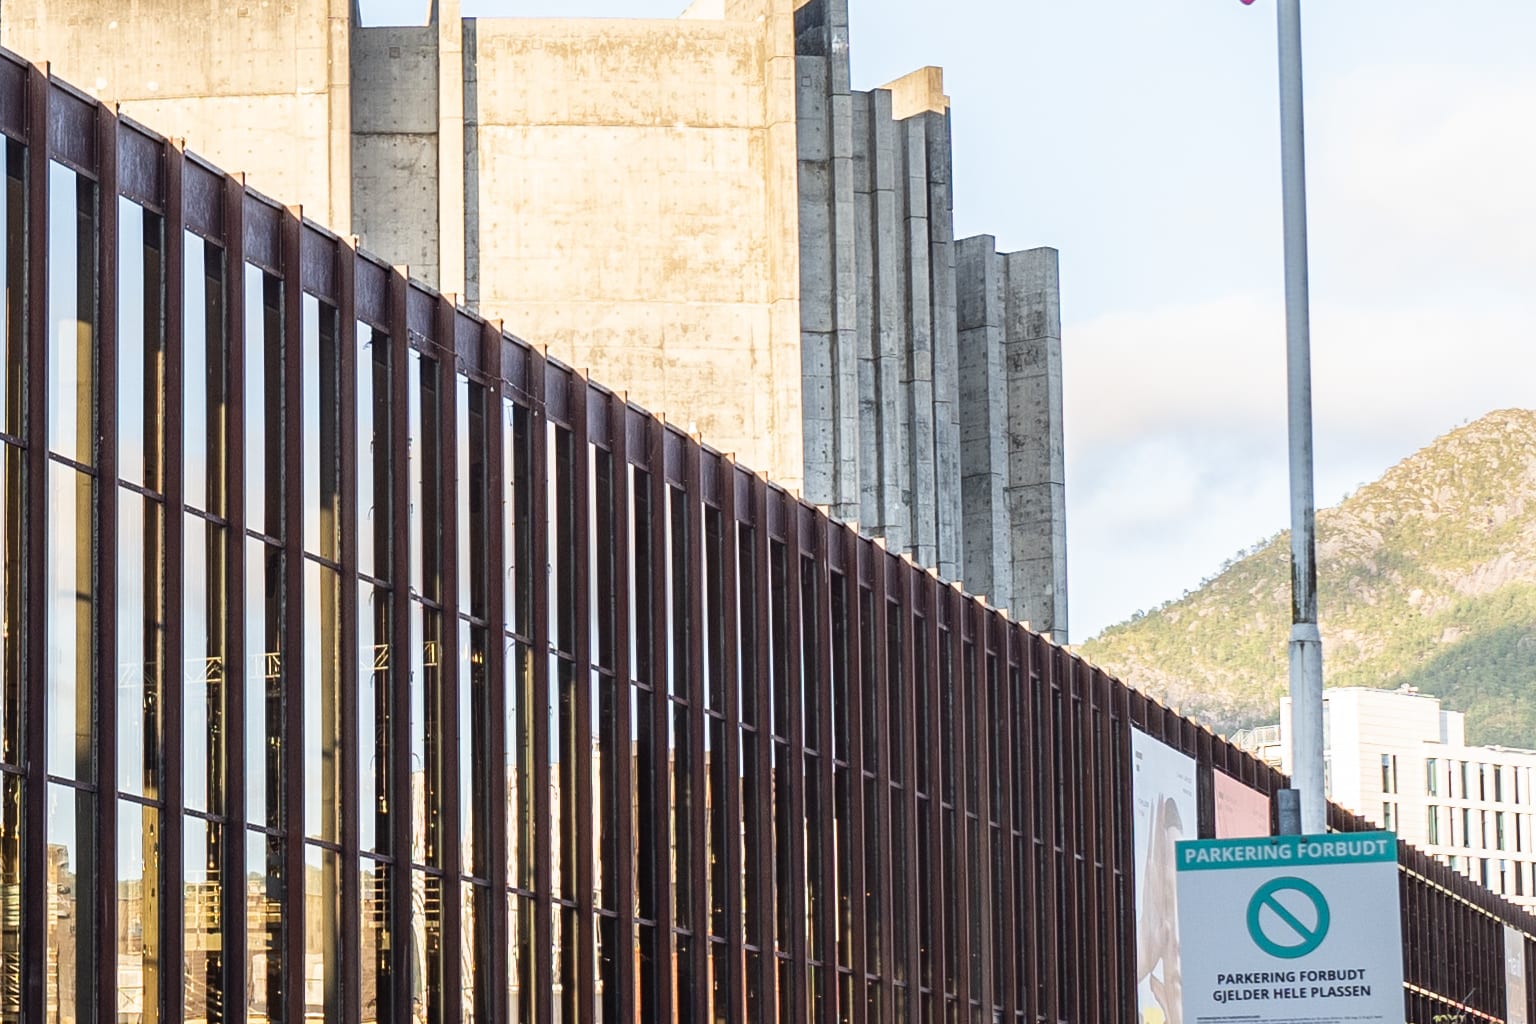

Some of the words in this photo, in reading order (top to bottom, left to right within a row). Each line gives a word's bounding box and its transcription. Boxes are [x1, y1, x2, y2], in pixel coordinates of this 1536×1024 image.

[1184, 844, 1293, 864] PARKERING
[1296, 839, 1388, 859] FORBUDT
[1217, 971, 1296, 985] PARKERING
[1299, 968, 1366, 982] FORBUDT
[1212, 988, 1270, 1004] GJELDER
[1273, 987, 1307, 1000] HELE
[1310, 985, 1372, 998] PLASSEN
